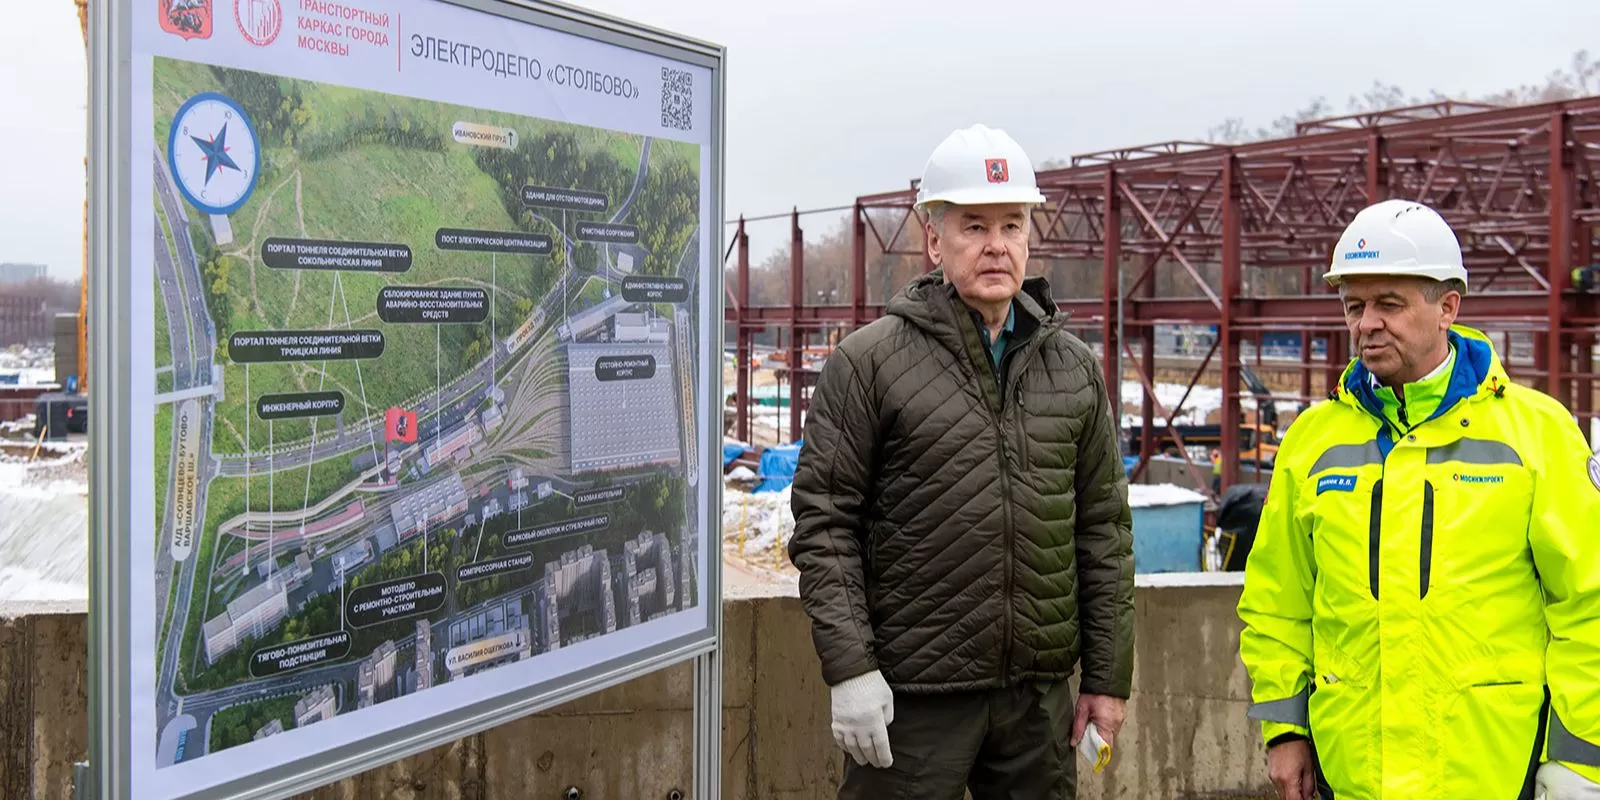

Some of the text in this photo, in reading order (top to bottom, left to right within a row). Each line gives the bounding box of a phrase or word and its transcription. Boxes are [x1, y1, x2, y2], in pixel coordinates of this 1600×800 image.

[299, 0, 390, 27] ТРАНСПОРТНЫЙ
[298, 16, 342, 36] КАРКАС
[346, 25, 389, 46] ГОРОДА
[298, 35, 349, 56] МОСКВЫ
[410, 33, 640, 100] ЭЛЕКТРОДЕПО «СТОЛБОВО»
[225, 111, 232, 120] Ю
[454, 129, 507, 144] ИВАНОВСКИЙ ПРУД
[525, 191, 545, 201] ЗДАНИЕ
[442, 235, 548, 249] ПОСТ ЭЛЕКТРИЧЕСКОЙ ЦЕНТРАЛИЗАЦИИ
[267, 244, 408, 258] ПОРТАЛ ТОННЕЛЯ СОЕДИНИТЕЛЬНОЙ ВЕТКИ
[298, 256, 382, 267] СОКОЛЬНИЧЕСКАЯ ЛИНИЯ
[383, 290, 484, 299] СБЛОКИРОВАННОЕ ЗДАНИЕ ПУНКТА
[385, 300, 484, 309] АВАРИЙНО-ВОССТАНОВИТЕЛЬНЫХ
[422, 311, 449, 319] СРЕДСТВ
[234, 335, 381, 346] ПОРТАЛ ТОННЕЛЯ СОЕДИНИТЕЛЬНОЙ ВЕТКИ
[280, 346, 342, 357] ТРОИЦКАЯ ЛИНИЯ
[262, 400, 340, 413] ИНЖЕНЕРНЫЙ КОРПУС
[1460, 475, 1504, 483] МОСИНЖПРОЕКТ
[184, 474, 194, 547] ВАРШАВСКОЕ
[508, 530, 536, 542] ПАРКОВЫЙ
[596, 516, 608, 526] ПОСТ
[175, 528, 184, 547] А/Д
[459, 556, 532, 577] КОМПРЕССОРНАЯ СТАНЦИЯ
[381, 582, 416, 596] МОТОДЕПО
[354, 586, 442, 613] С РЕМОНТНО-СТРОИТЕЛЬНЫМ
[382, 602, 416, 616] УЧАСТКОМ
[258, 634, 348, 662] ТЯГОВО-ПОНИЗИТЕЛЬНАЯ
[279, 650, 326, 669] ПОДСТАНЦИЯ
[448, 656, 457, 666] УЛ.
[458, 649, 483, 662] ВАСИЛИЯ
